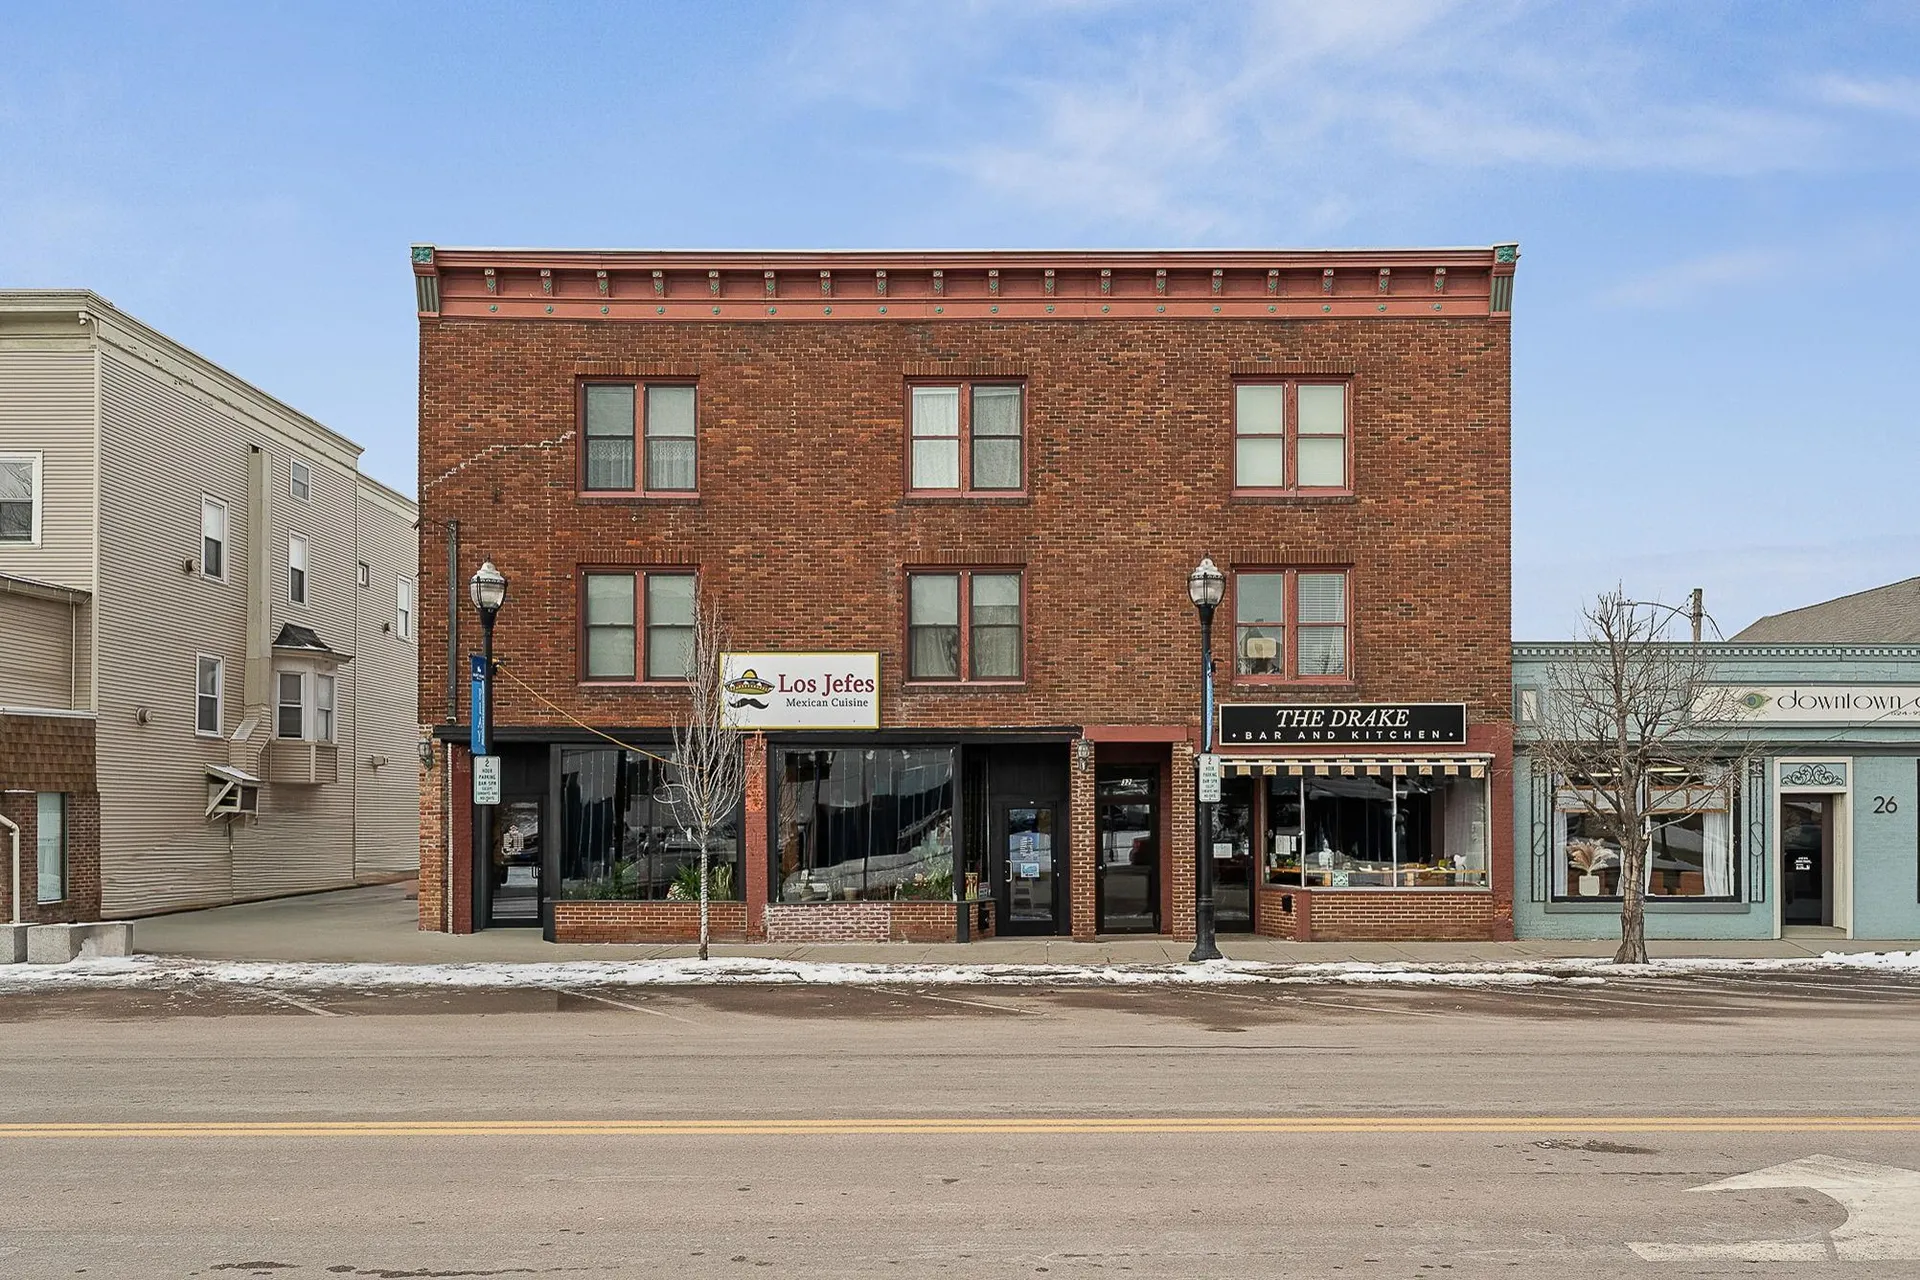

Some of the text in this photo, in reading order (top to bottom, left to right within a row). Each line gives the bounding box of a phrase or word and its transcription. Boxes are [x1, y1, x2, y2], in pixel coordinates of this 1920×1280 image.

[778, 673, 875, 697] Los Jefes
[786, 697, 869, 707] Mexican Cuisine
[1777, 689, 1901, 710] downtown
[1276, 709, 1410, 728] THE DRAKE
[1245, 730, 1441, 740] BAR AND KITCHEN
[1873, 796, 1898, 814] 26
